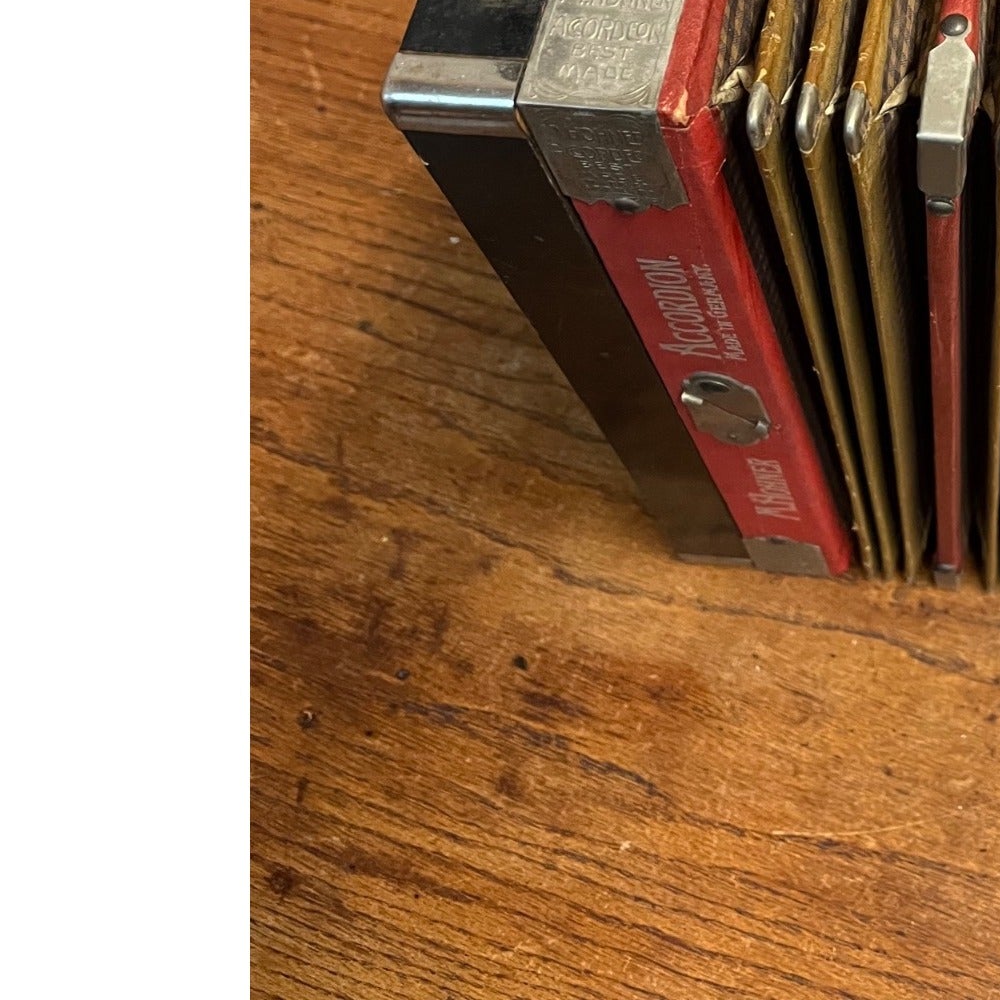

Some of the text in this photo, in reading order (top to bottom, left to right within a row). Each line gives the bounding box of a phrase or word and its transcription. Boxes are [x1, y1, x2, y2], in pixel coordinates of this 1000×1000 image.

[571, 43, 634, 60] BEST
[557, 63, 634, 84] MADE
[636, 255, 722, 360] ACCORDION.
[716, 319, 735, 331] IN
